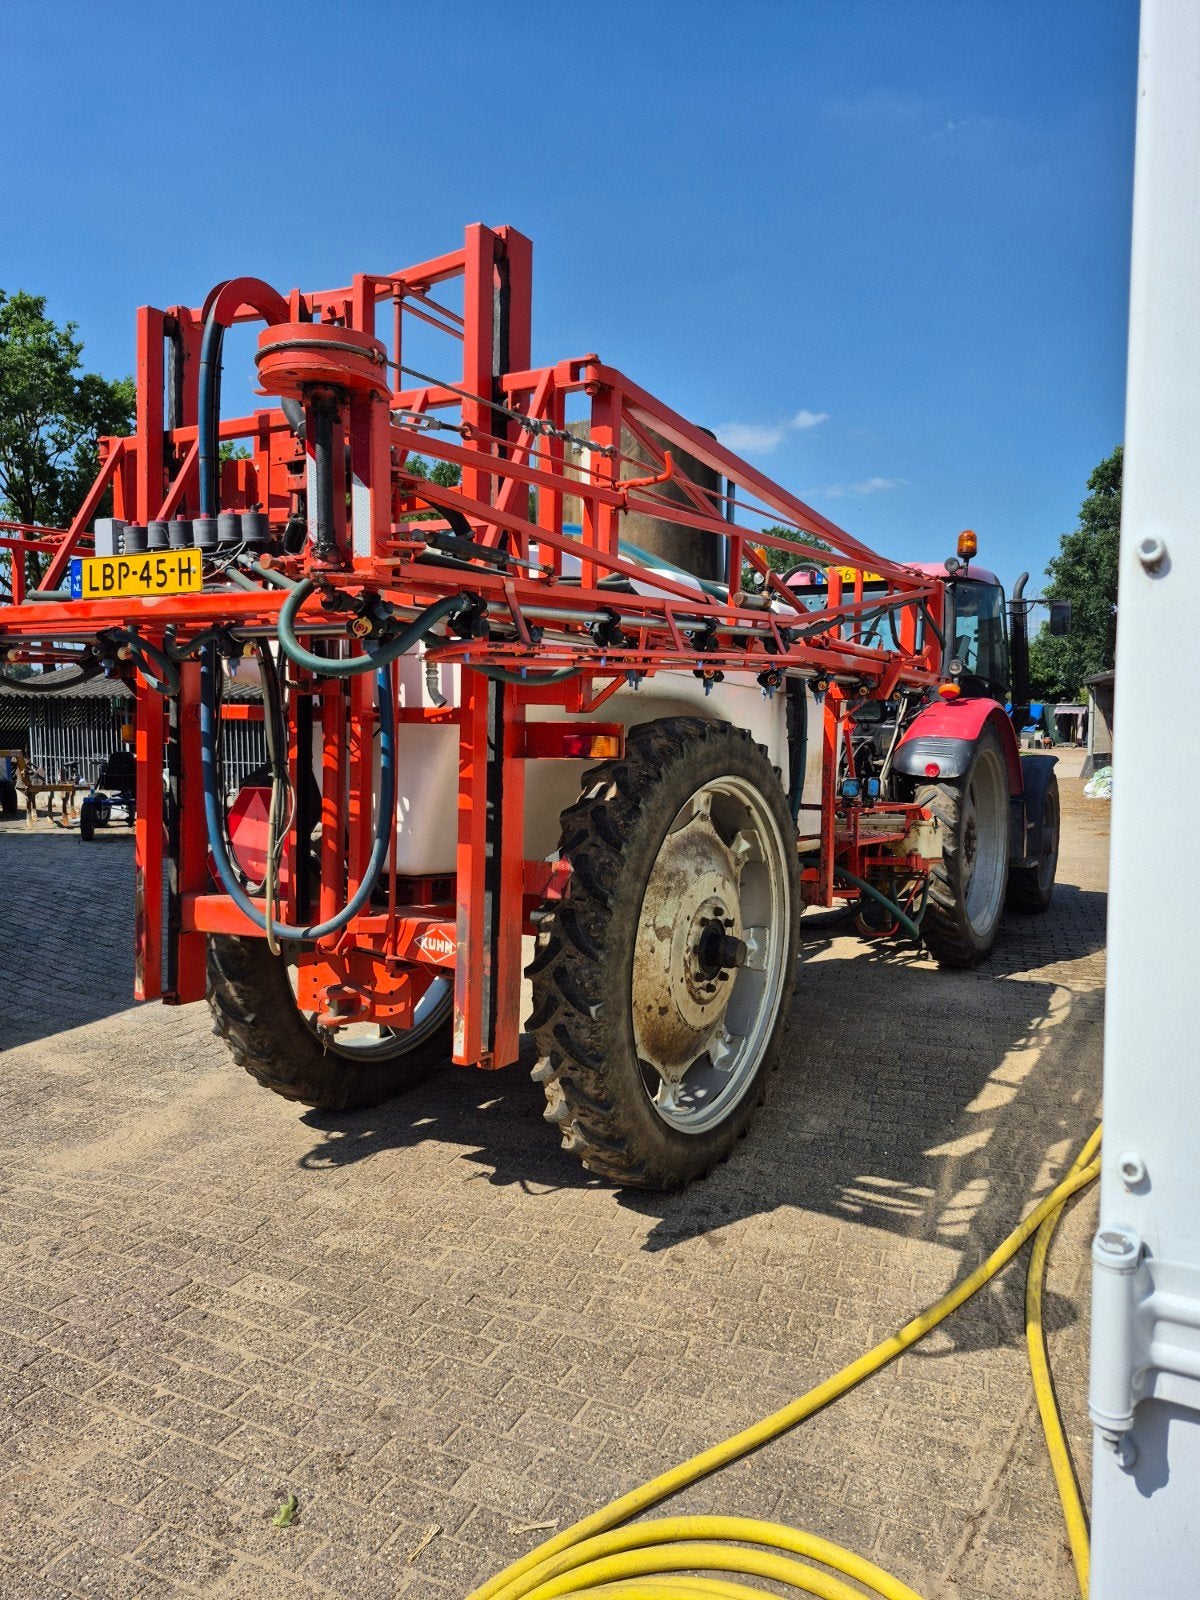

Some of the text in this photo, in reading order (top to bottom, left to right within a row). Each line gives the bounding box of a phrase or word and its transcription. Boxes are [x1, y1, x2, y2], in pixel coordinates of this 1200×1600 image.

[89, 557, 191, 591] LBP-45-H
[73, 583, 82, 592] NL
[420, 936, 453, 954] KUHN
